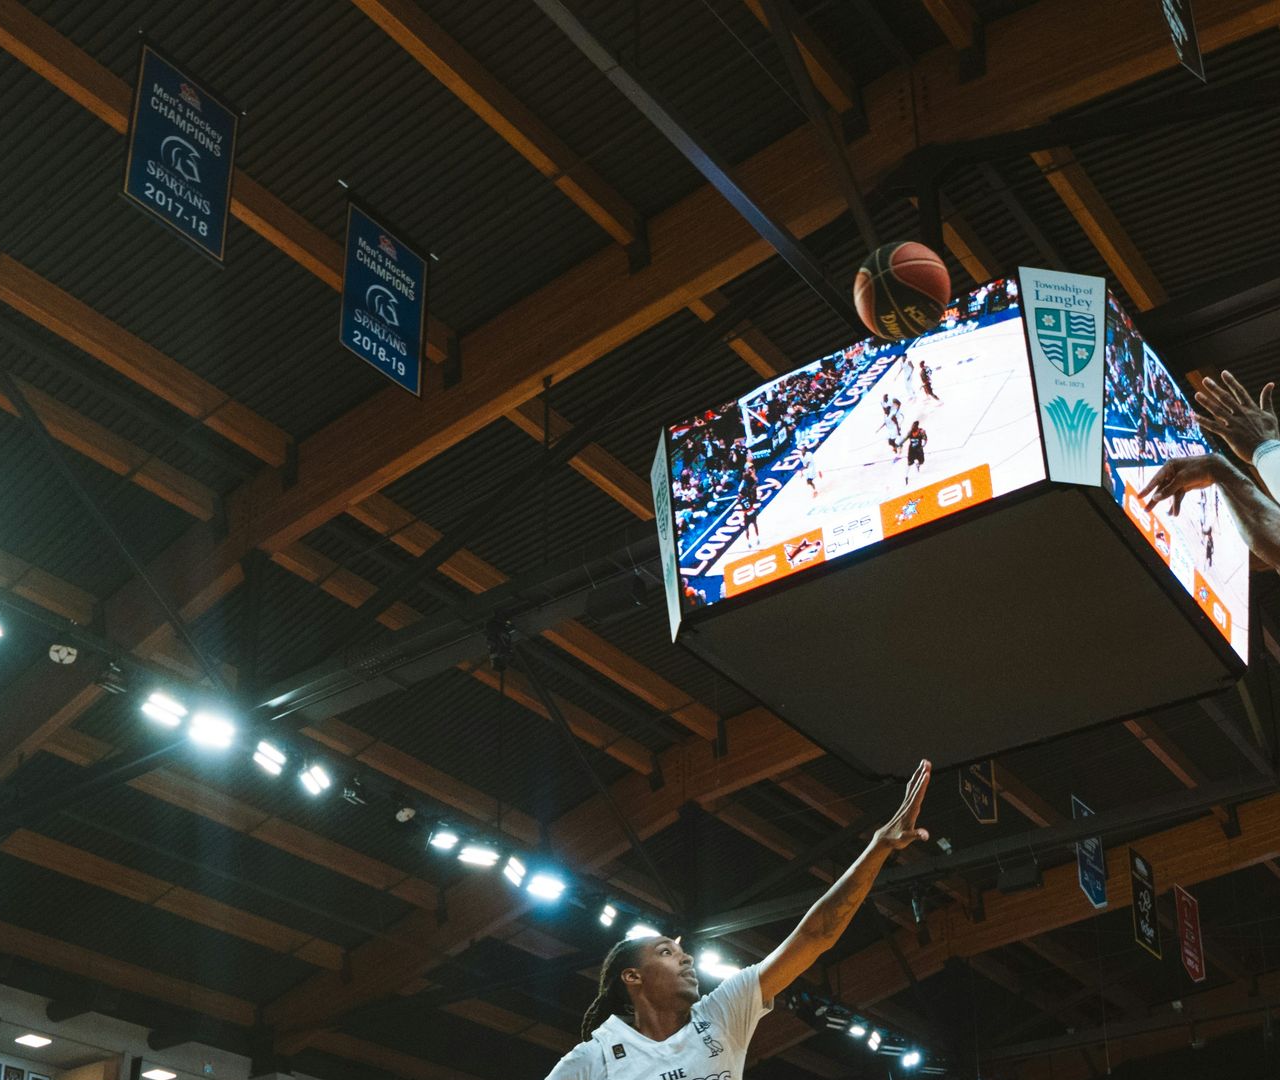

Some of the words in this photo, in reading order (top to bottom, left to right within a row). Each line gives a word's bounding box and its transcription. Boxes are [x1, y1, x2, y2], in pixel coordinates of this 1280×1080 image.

[150, 95, 222, 158] CHAMPIONS
[186, 103, 223, 145] Hockey
[143, 182, 208, 238] 2017-18
[146, 159, 212, 217] SPARTANS
[355, 248, 416, 302] CHAMPIONS
[1032, 279, 1081, 294] Township
[1082, 286, 1094, 296] of
[1033, 289, 1094, 311] Langley
[352, 329, 406, 378] 2018-19
[353, 308, 408, 357] SPARTANS
[937, 479, 972, 508] 81
[733, 554, 777, 586] 86
